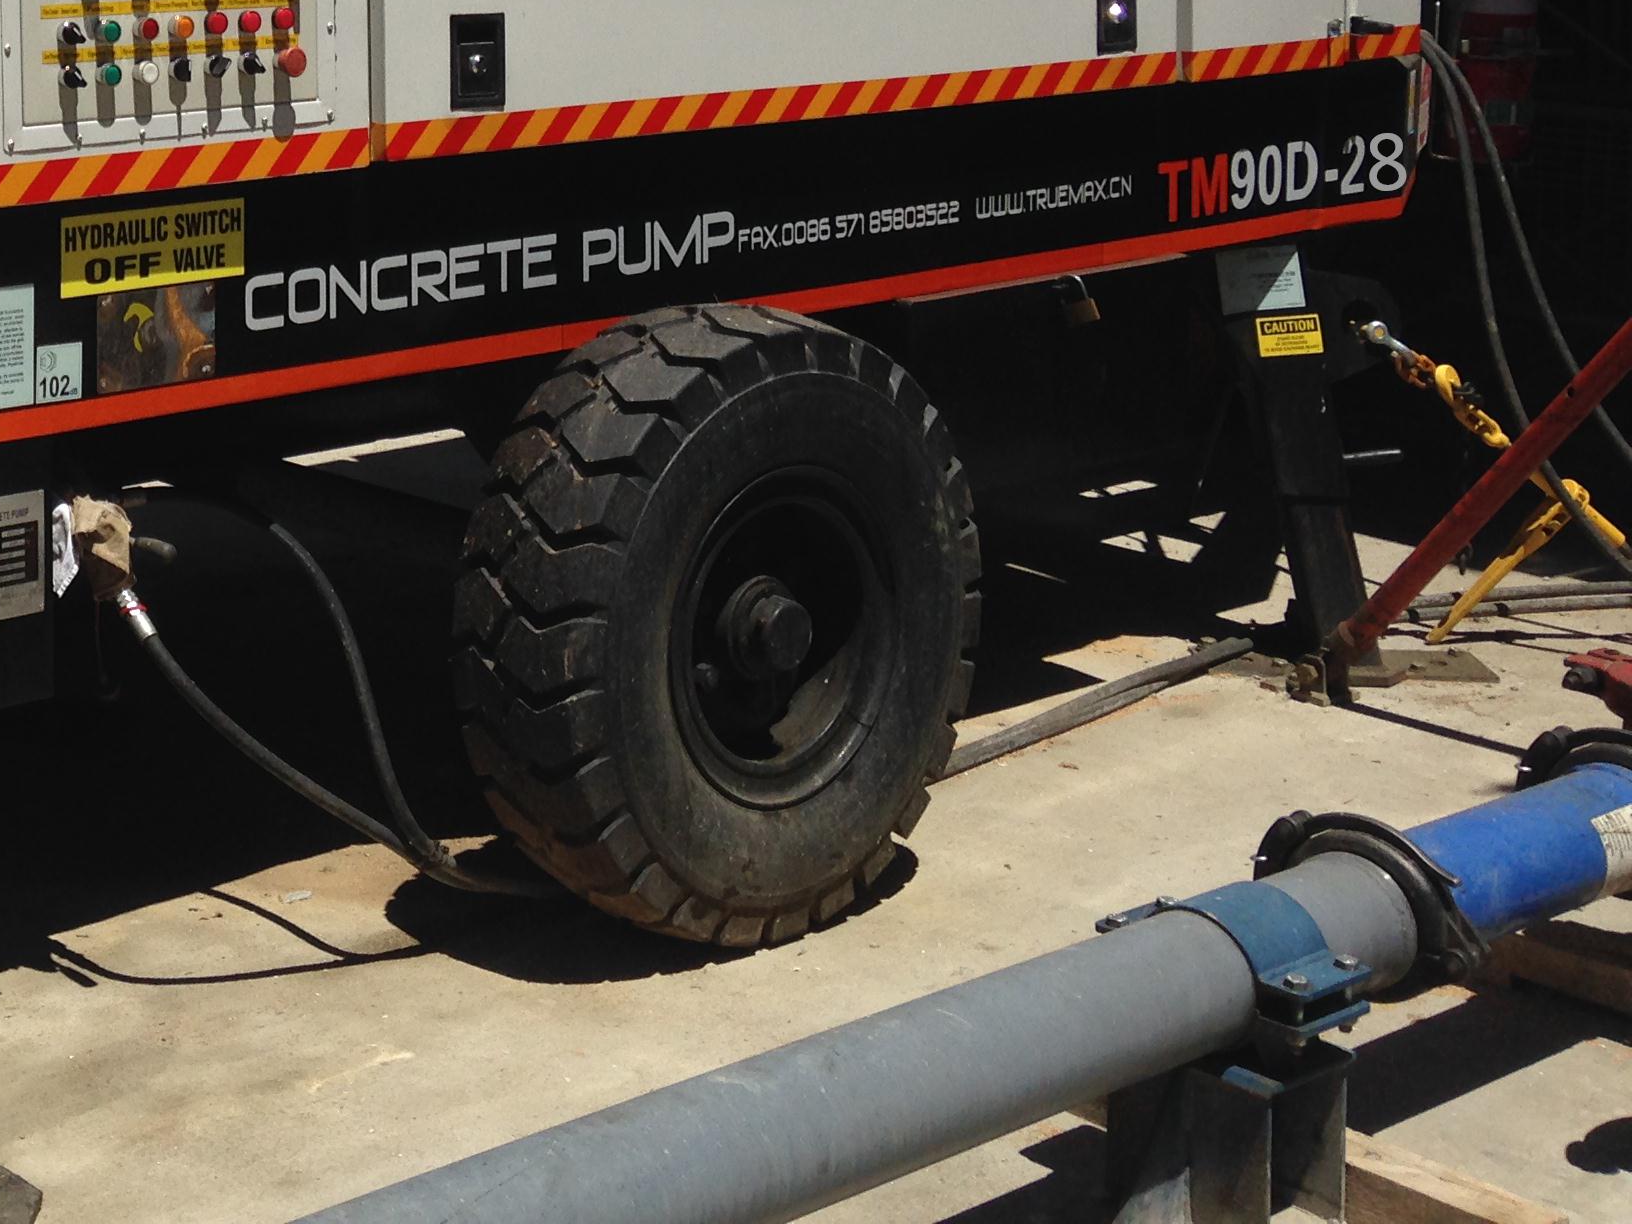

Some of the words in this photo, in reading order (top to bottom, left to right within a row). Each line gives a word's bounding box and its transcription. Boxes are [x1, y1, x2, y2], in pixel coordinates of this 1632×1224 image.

[975, 174, 1133, 221] WWW.TRUEMAX.CN
[1157, 131, 1408, 223] TM90D-28
[64, 215, 168, 253] HYDRAULIC
[175, 206, 242, 240] SWITCH
[834, 212, 865, 240] 571
[868, 199, 961, 236] 85803522
[84, 251, 162, 285] OFF
[172, 243, 226, 274] VALVE
[244, 233, 558, 332] CONCRETE
[582, 210, 735, 283] PUMP
[1263, 319, 1315, 334] CAUTION
[39, 374, 70, 399] 102
